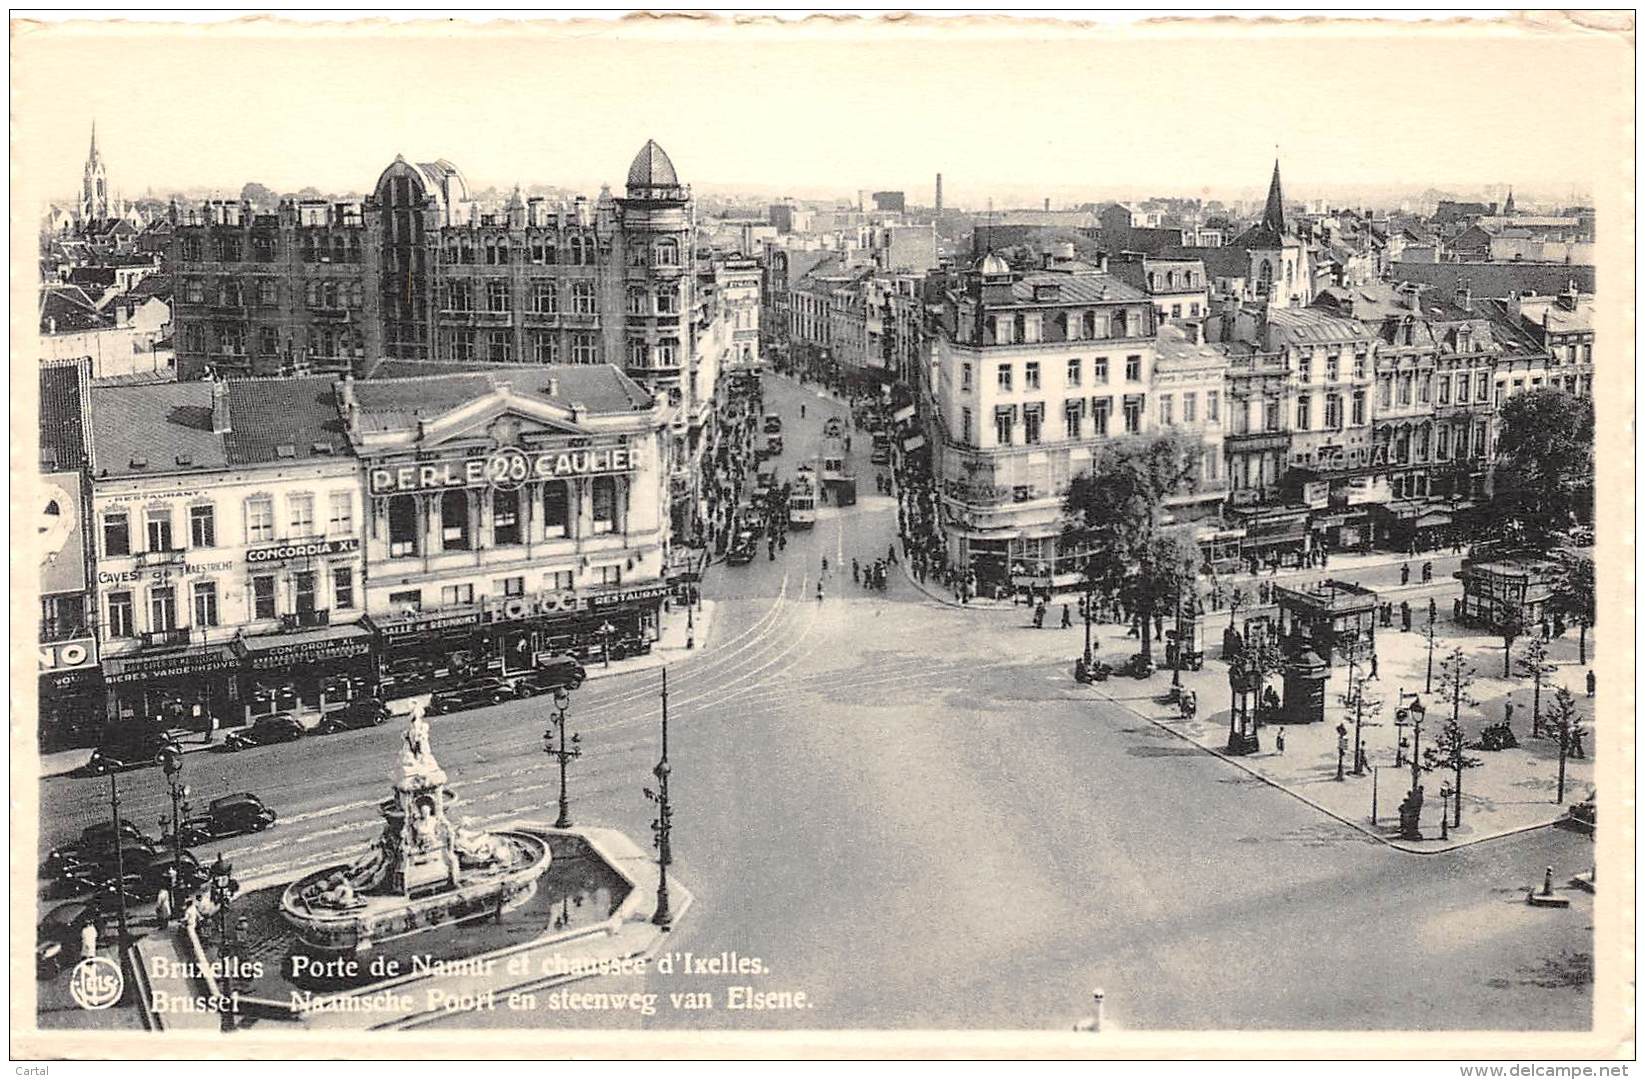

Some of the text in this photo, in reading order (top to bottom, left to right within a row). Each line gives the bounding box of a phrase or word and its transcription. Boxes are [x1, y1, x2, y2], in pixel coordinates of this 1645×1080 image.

[373, 449, 641, 491] PERLE 28 CAULIER
[248, 541, 358, 561] CONCORDIA XL
[98, 570, 139, 584] CAVES
[594, 587, 674, 606] RESTAURANT
